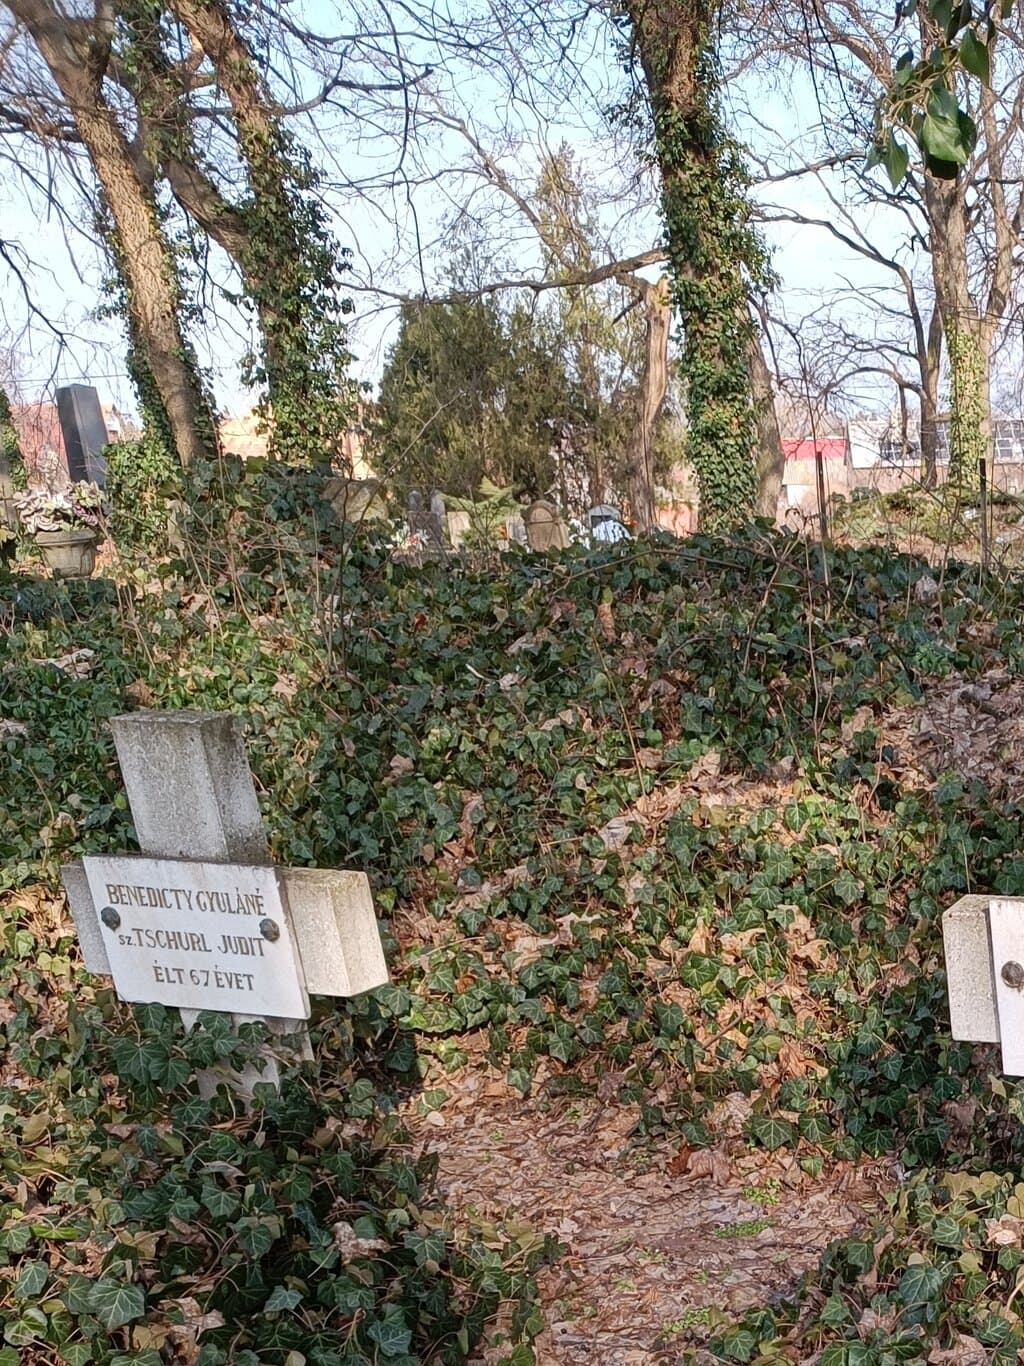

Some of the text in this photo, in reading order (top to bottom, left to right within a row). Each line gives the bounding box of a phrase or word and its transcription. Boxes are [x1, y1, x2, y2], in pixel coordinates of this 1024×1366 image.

[106, 884, 266, 916] BENEDICTY GYULÁNÉ
[218, 934, 266, 957] JUDIT
[153, 960, 255, 991] ÉLT 67 ÉVET
